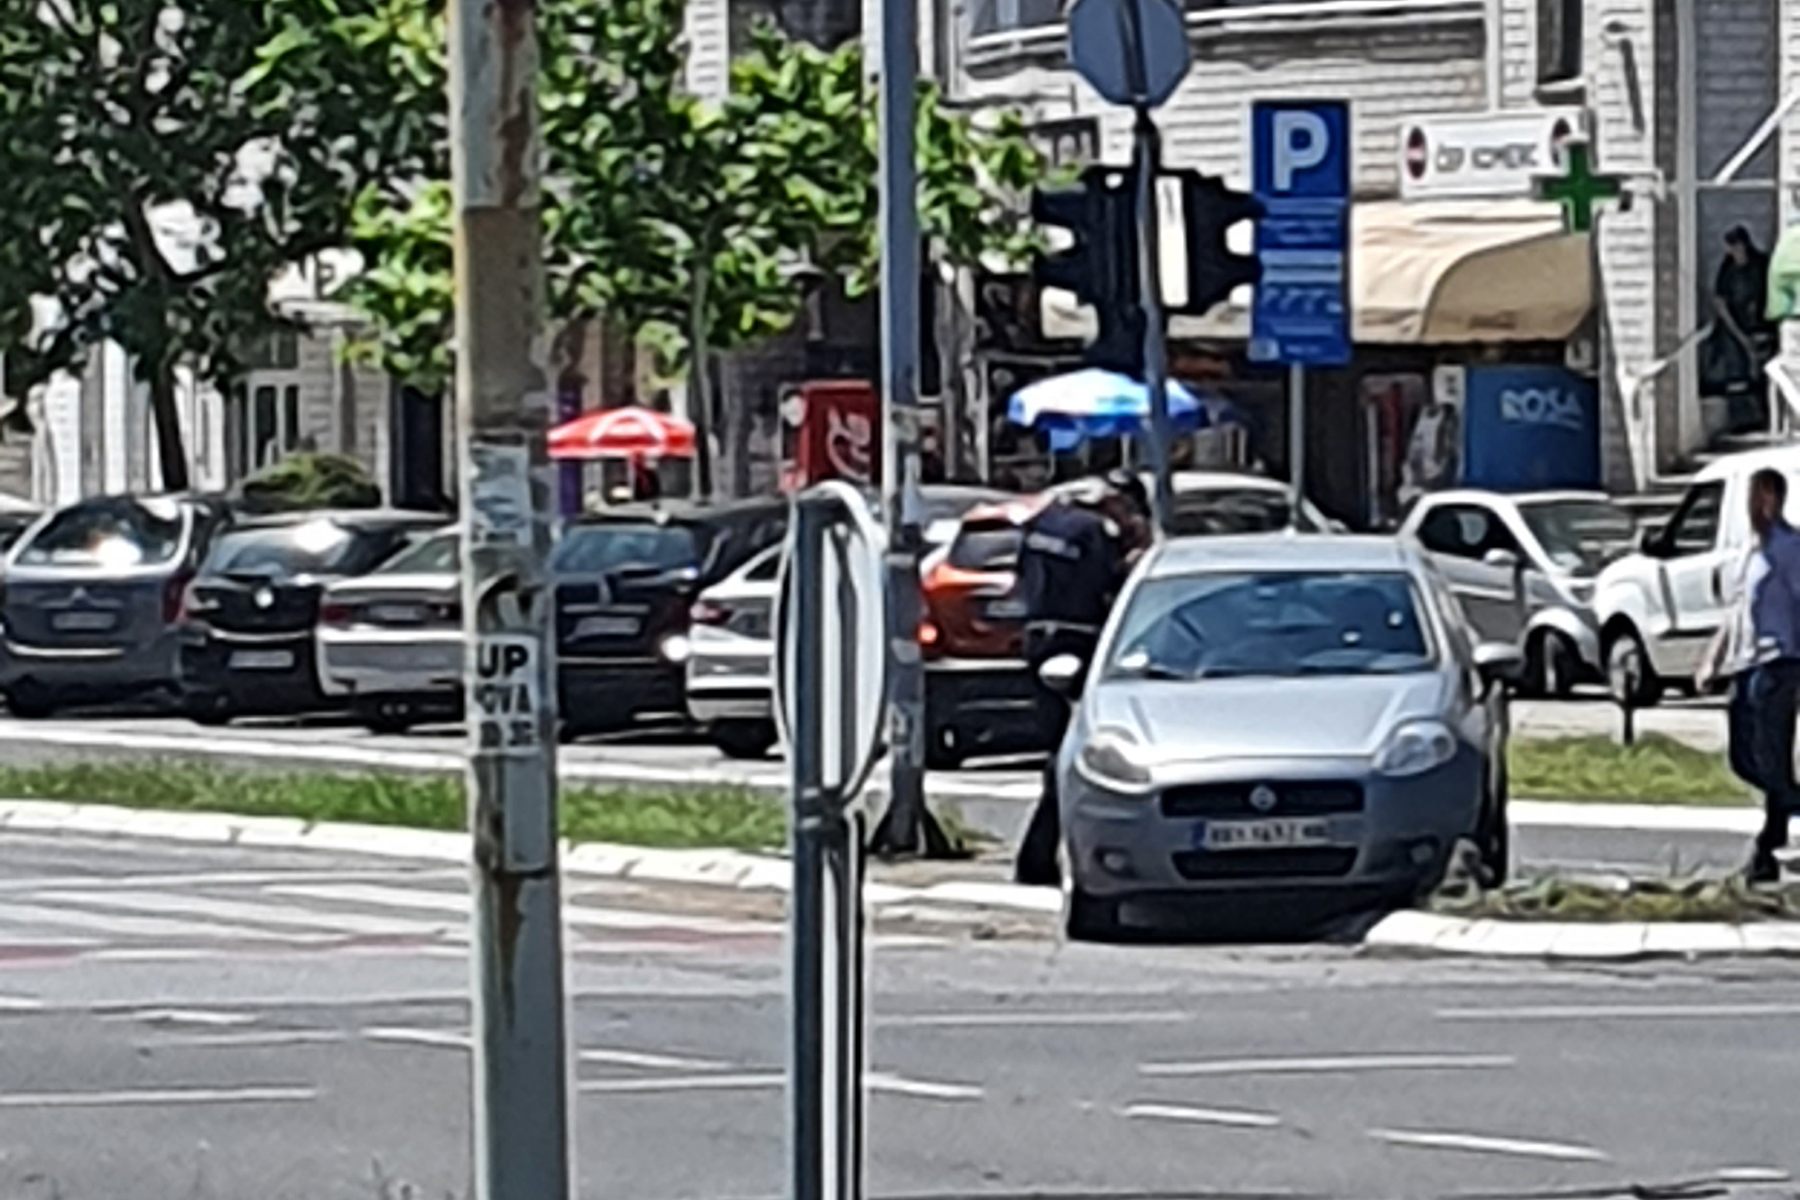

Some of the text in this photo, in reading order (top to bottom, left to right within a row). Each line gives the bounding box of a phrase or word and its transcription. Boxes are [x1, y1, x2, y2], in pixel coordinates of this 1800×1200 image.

[1273, 109, 1329, 191] P
[1502, 387, 1584, 422] ROSA
[478, 644, 529, 679] UP
